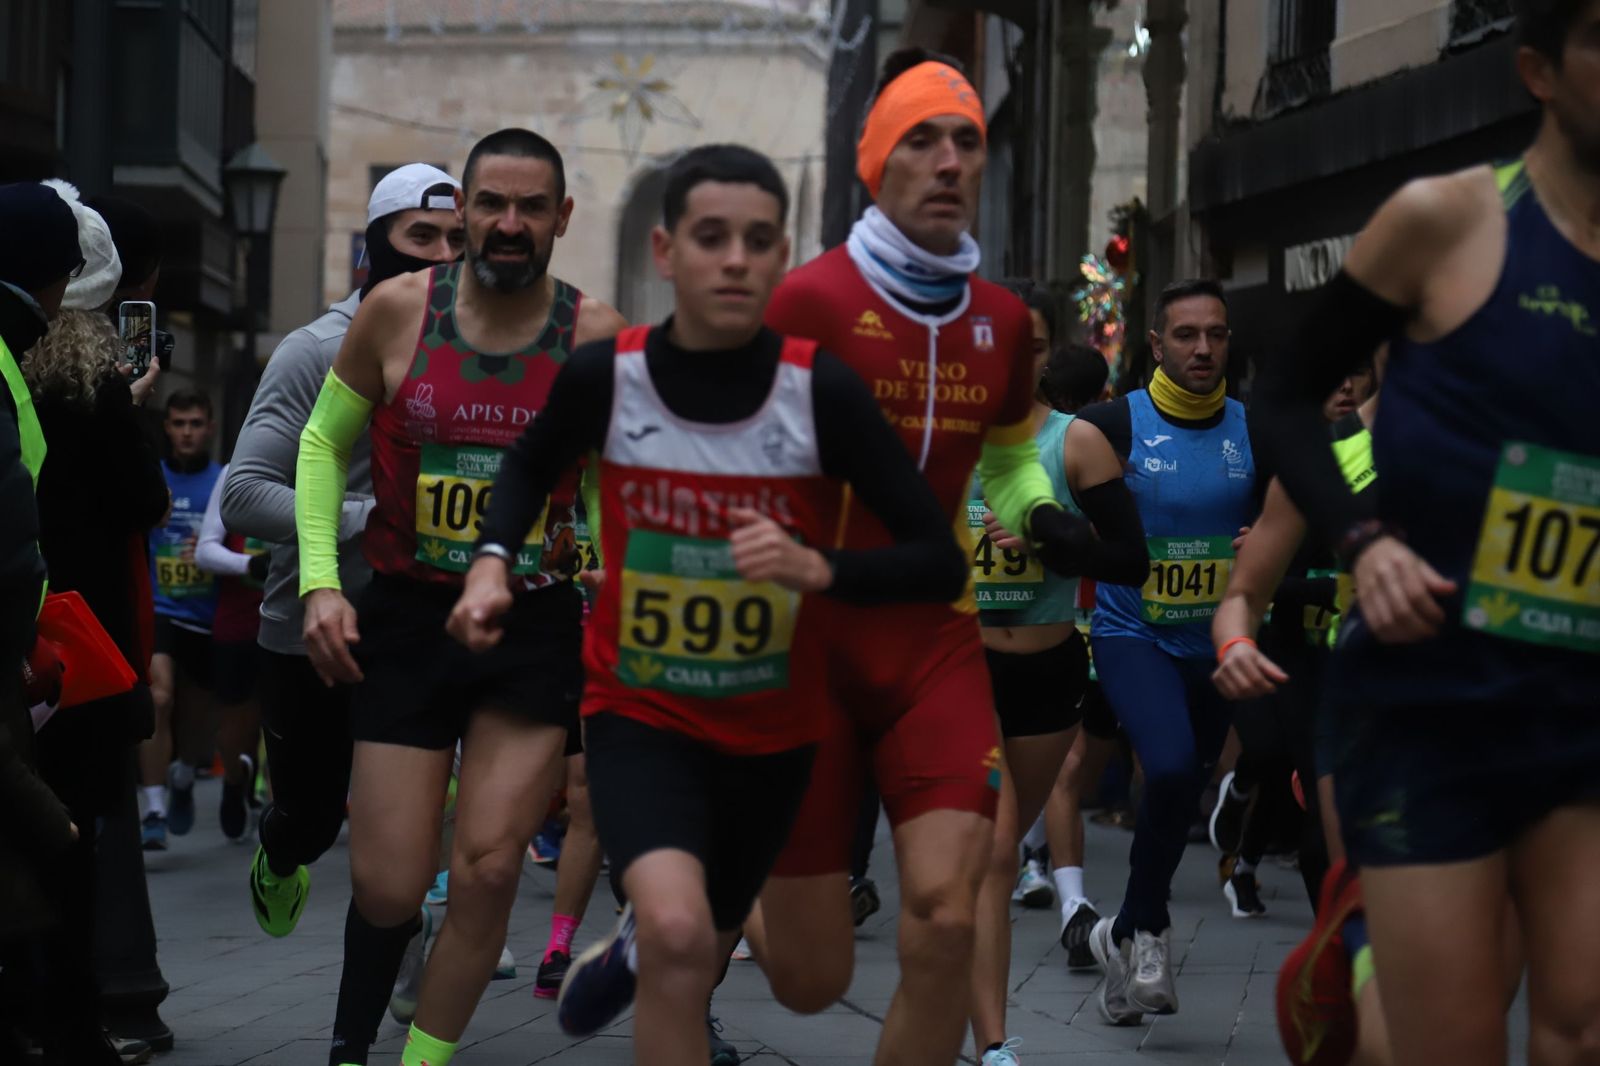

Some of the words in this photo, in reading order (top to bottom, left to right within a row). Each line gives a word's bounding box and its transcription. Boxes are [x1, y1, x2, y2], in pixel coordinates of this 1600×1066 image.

[899, 359, 967, 382] VINO
[874, 378, 908, 400] DE
[914, 384, 989, 404] TORO
[452, 404, 505, 422] APIS
[975, 534, 1027, 576] 49
[1504, 503, 1600, 587] 107
[1152, 562, 1216, 597] 1041
[995, 591, 1036, 601] RURAL
[631, 589, 772, 656] 599
[1165, 607, 1190, 619] CAJA
[665, 664, 713, 687] CAJA
